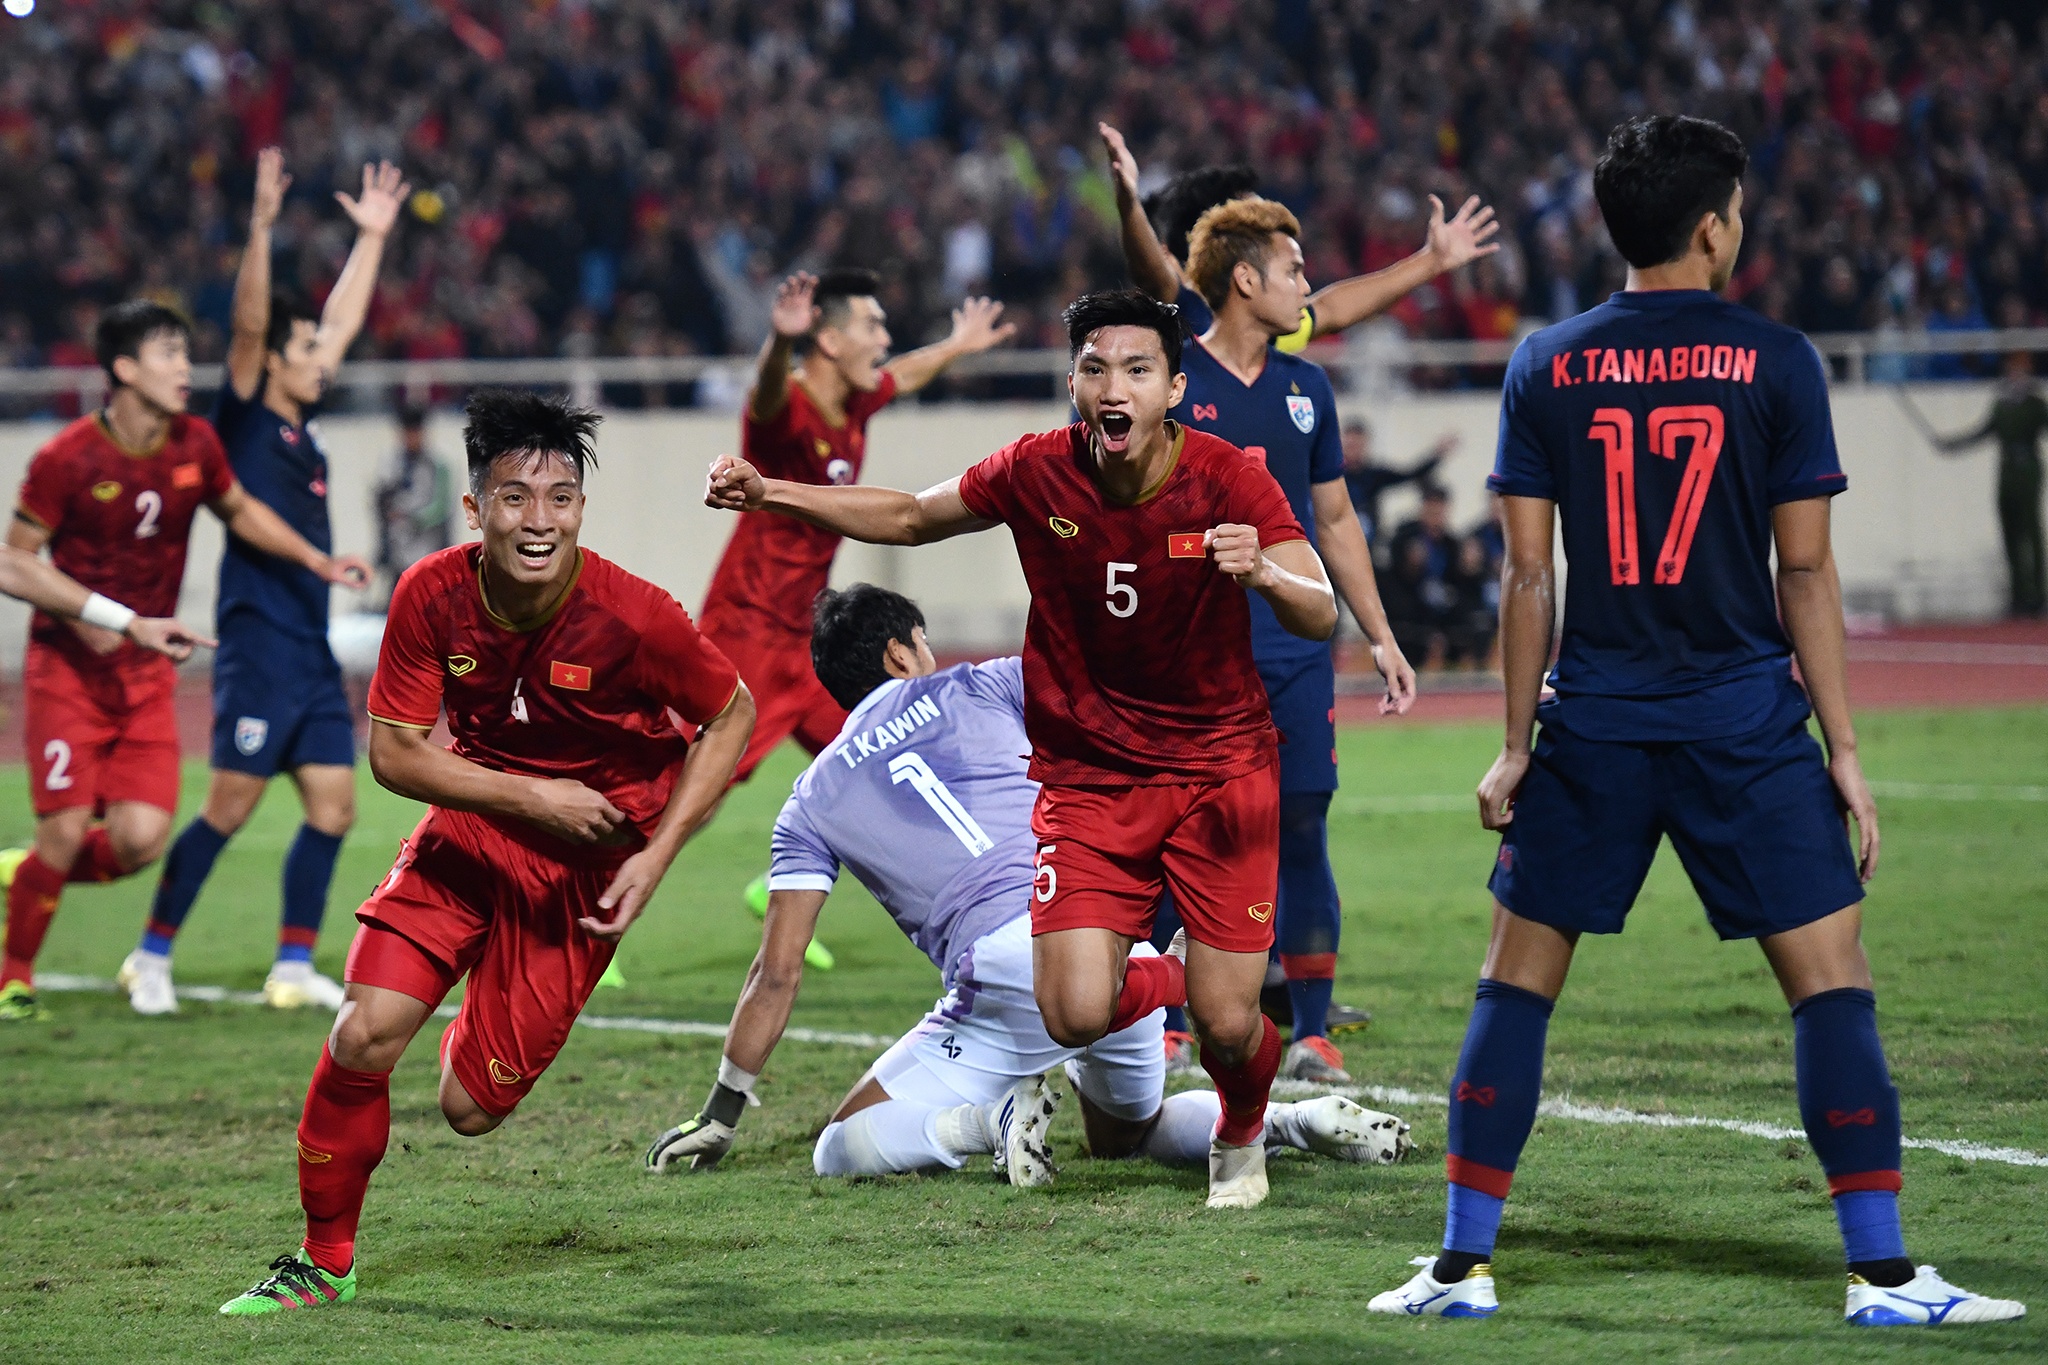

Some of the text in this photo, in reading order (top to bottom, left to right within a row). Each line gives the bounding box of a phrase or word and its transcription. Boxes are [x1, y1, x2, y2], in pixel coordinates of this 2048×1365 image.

[1552, 345, 1757, 388] K.TANABOON
[135, 490, 161, 539] 2
[1587, 405, 1725, 586] 17
[1106, 562, 1138, 618] 5
[836, 694, 941, 769] T.KAWIN
[44, 738, 74, 791] 2
[888, 752, 995, 858] 1
[1036, 845, 1057, 903] 5
